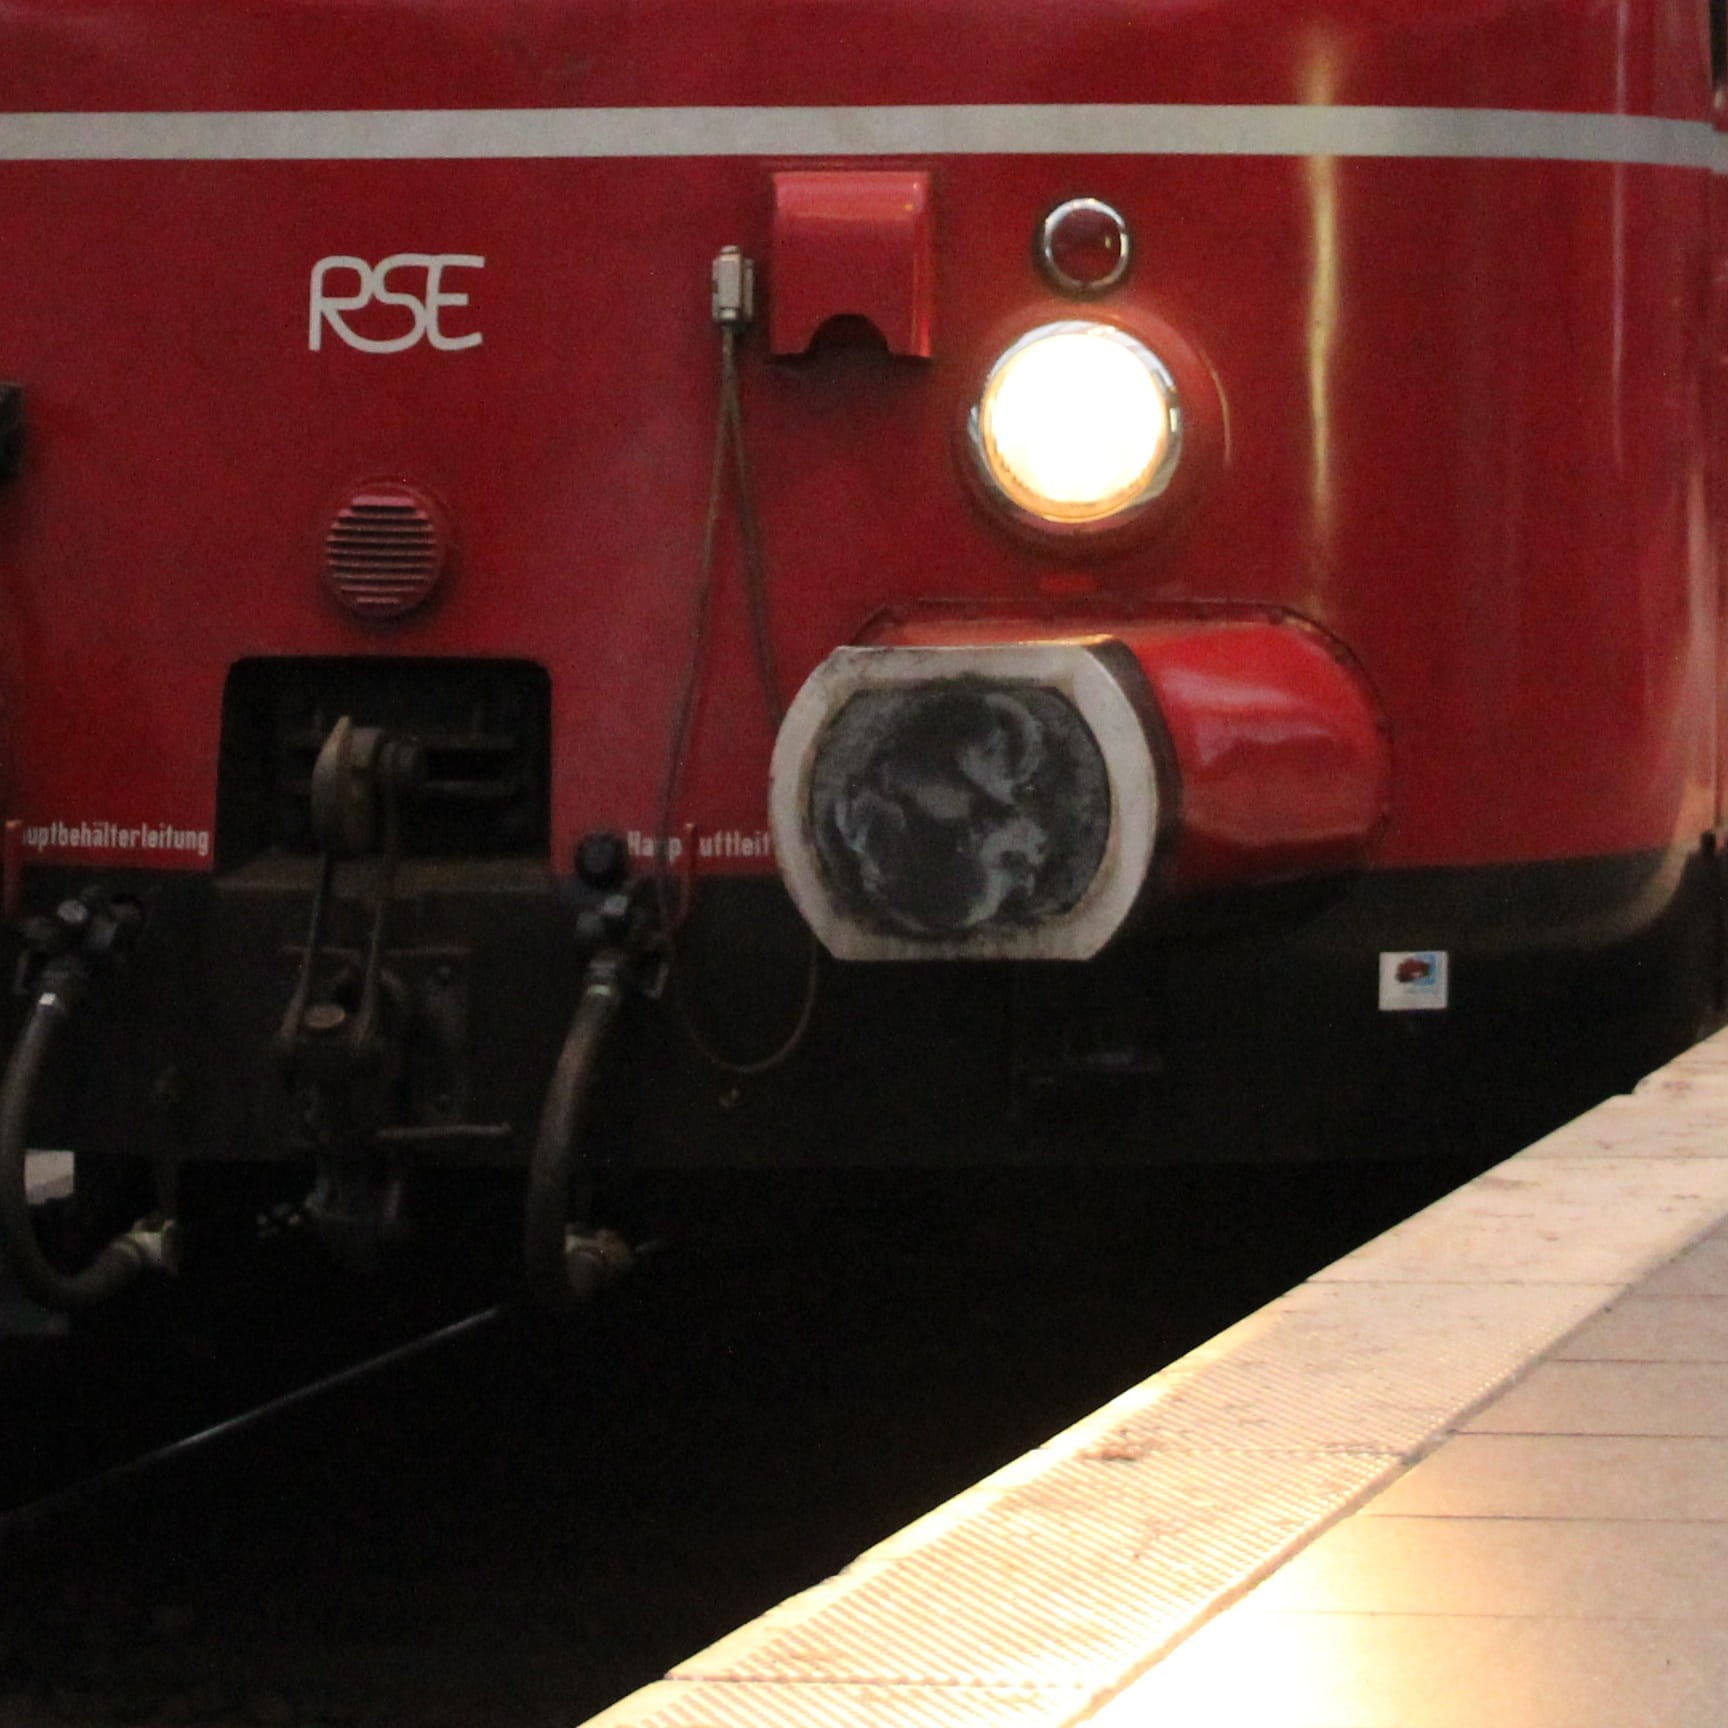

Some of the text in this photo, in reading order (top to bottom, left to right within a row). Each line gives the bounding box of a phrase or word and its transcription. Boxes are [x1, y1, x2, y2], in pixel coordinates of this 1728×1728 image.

[308, 252, 486, 354] RSE
[23, 821, 210, 856] uptbehälterleitung
[627, 829, 771, 865] Hapuftleit
